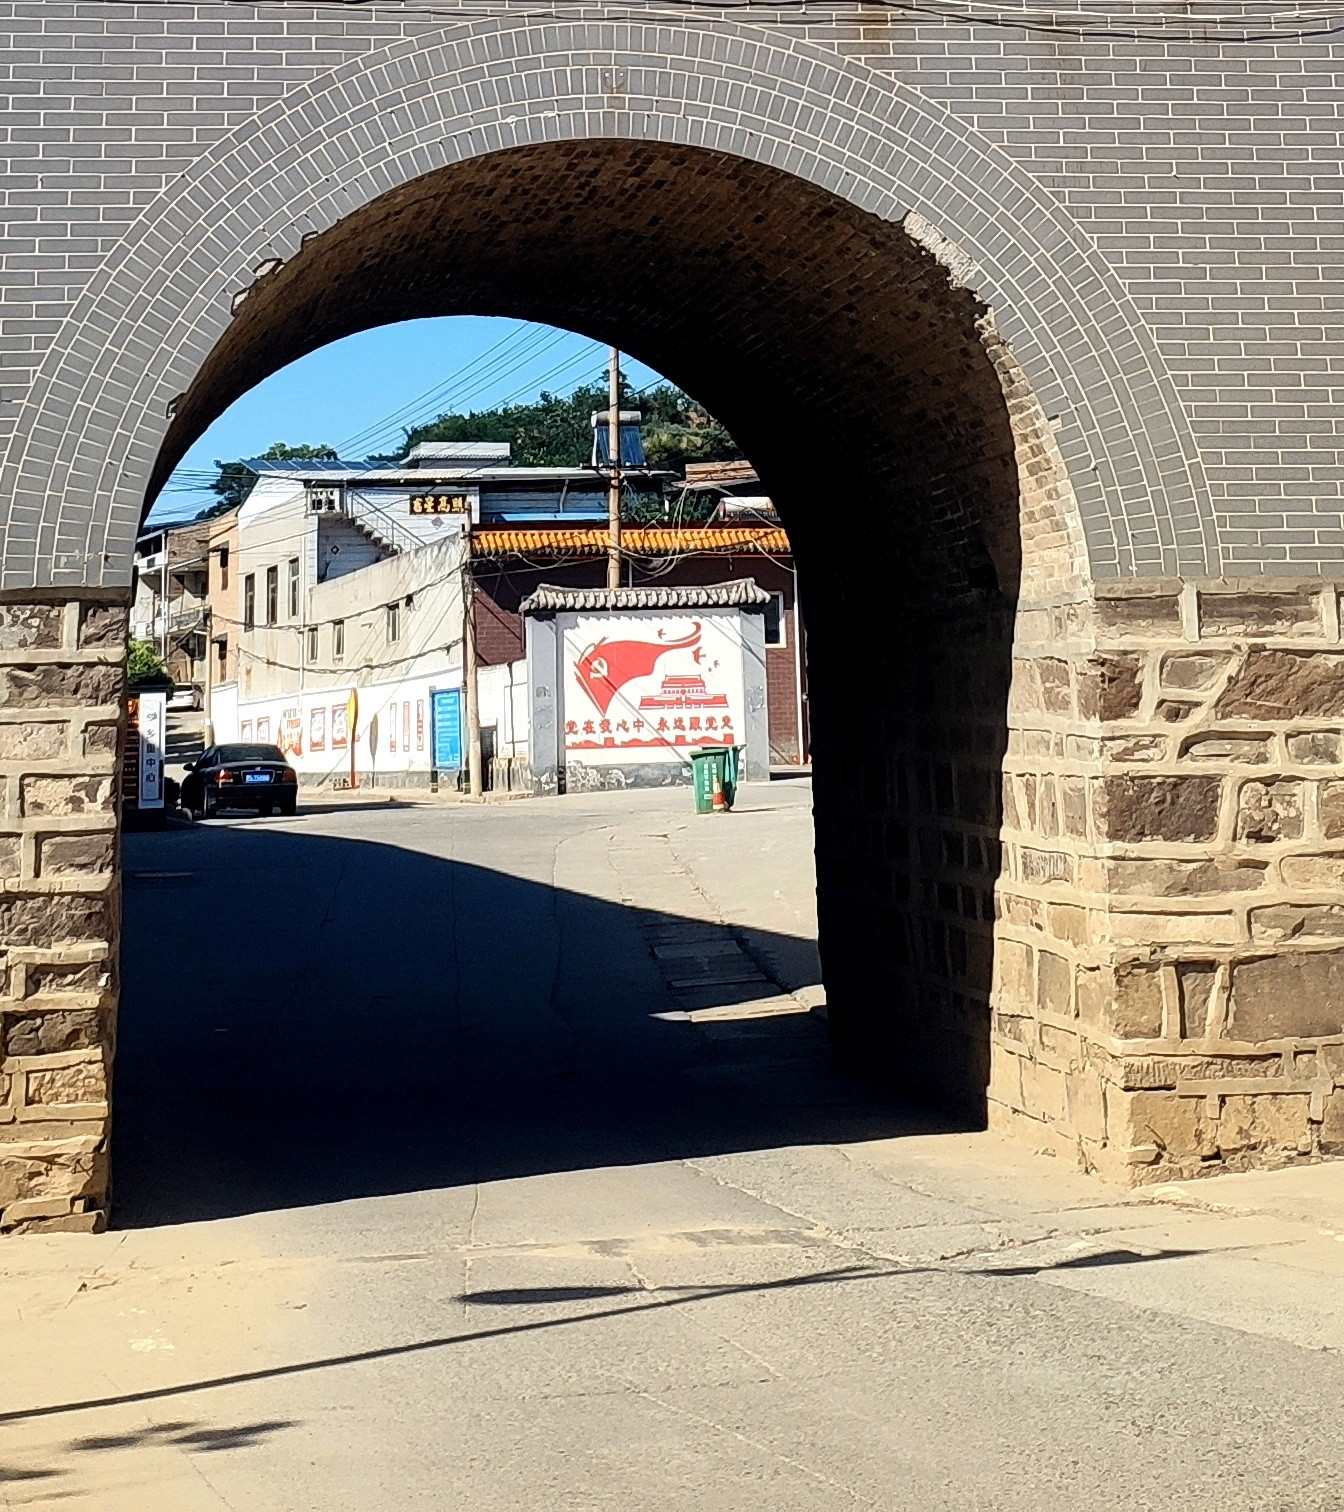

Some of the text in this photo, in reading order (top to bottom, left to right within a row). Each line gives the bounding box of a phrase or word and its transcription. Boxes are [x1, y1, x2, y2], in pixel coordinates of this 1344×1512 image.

[657, 714, 734, 732] 永远跟党走
